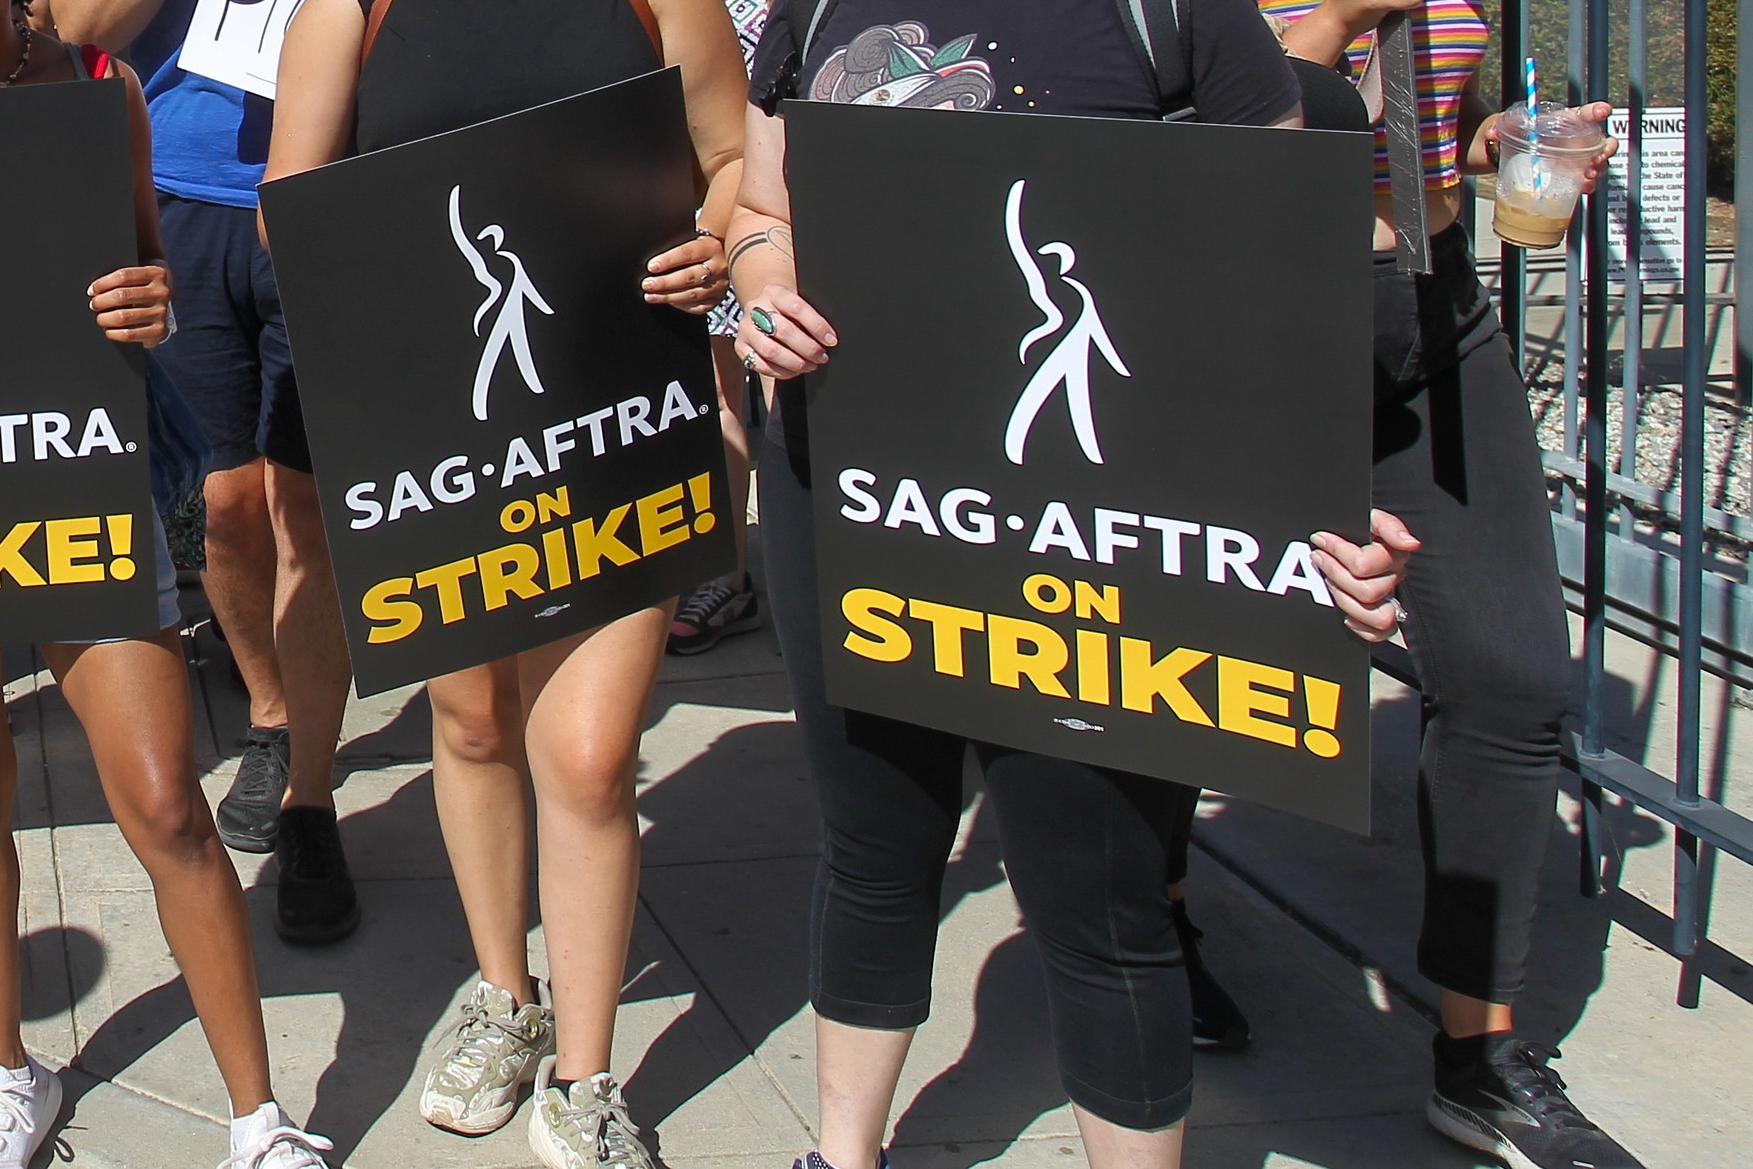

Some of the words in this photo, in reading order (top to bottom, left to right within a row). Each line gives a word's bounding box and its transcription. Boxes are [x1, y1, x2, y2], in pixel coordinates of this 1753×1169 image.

[1612, 118, 1686, 134] WRNING
[499, 486, 571, 533] ON
[360, 472, 716, 644] STRIKE!
[1021, 573, 1121, 624] ON
[841, 588, 1341, 759] STRIKE!
